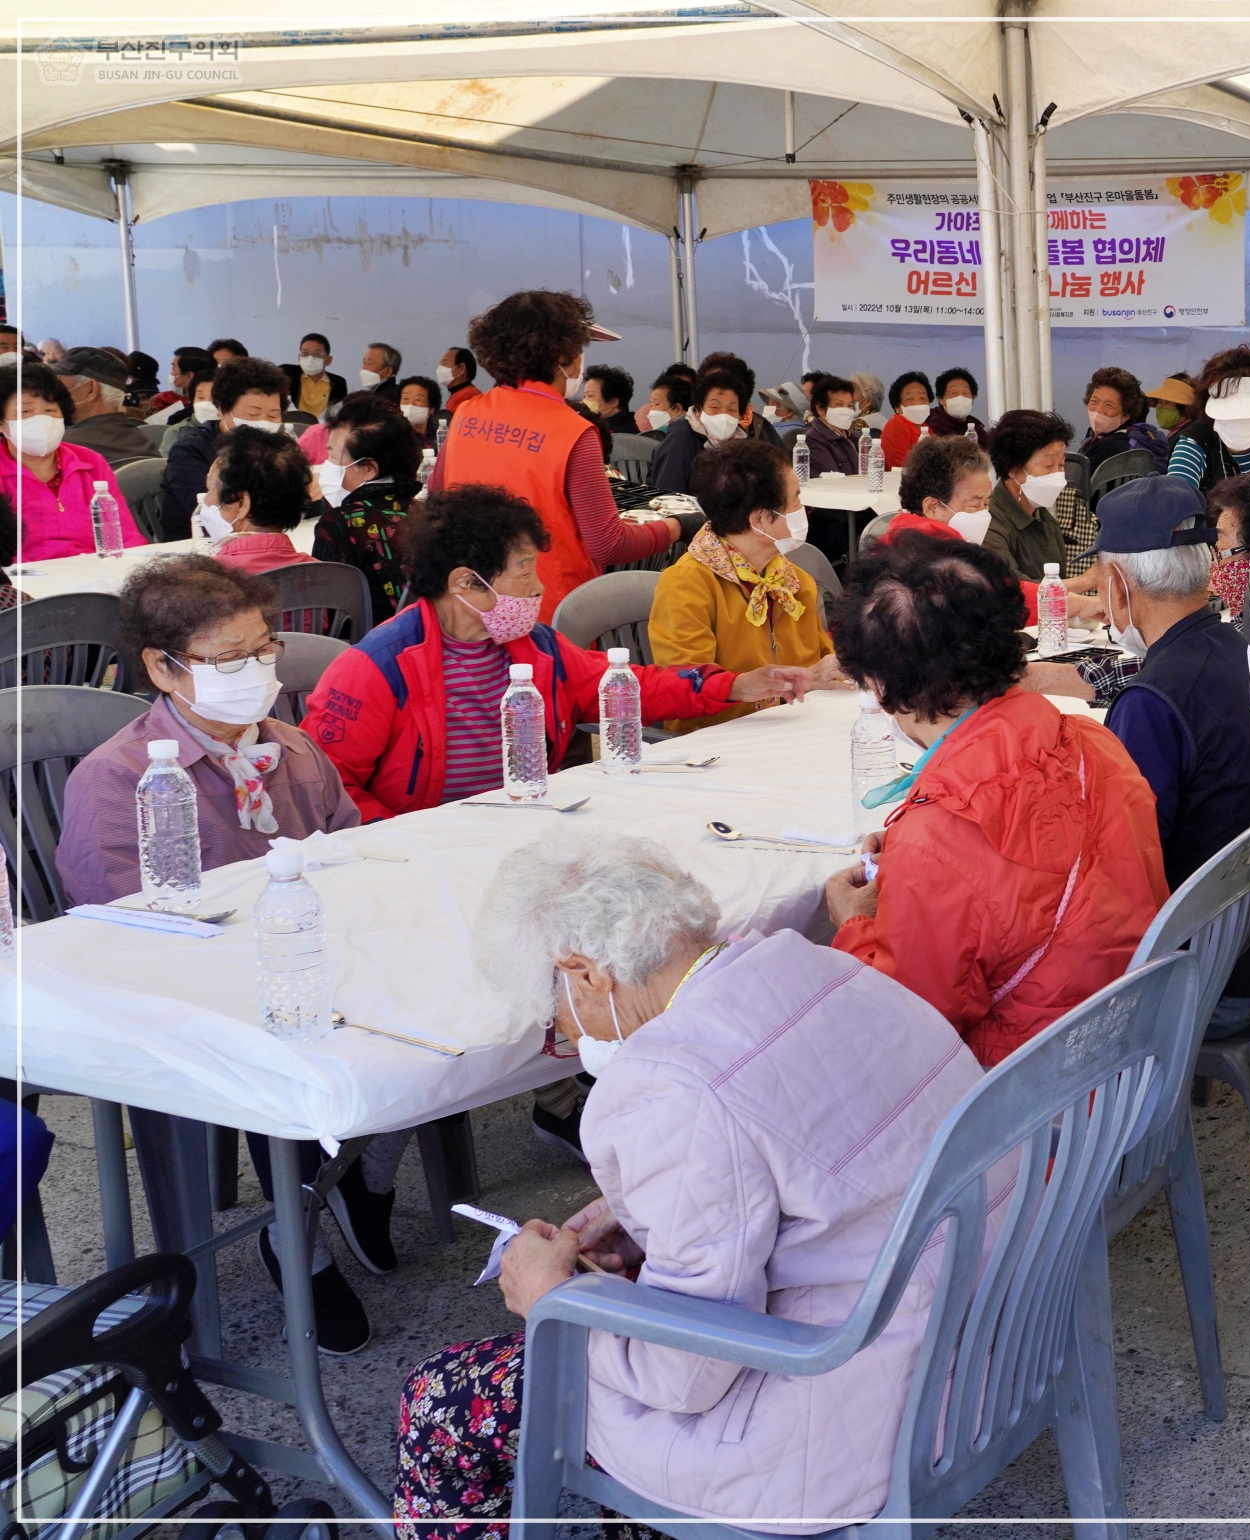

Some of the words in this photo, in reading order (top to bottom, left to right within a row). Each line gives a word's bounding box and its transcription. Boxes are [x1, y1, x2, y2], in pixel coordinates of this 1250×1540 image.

[887, 193, 950, 205] 주민생활현장의
[950, 194, 979, 205] 공공서
[1047, 209, 1107, 231] 께하는
[890, 238, 982, 265] 우리동네
[1092, 236, 1166, 265] 협의체
[906, 270, 978, 297] 어르신
[1048, 272, 1092, 298] 나눔
[1099, 269, 1146, 297] 행사
[859, 303, 883, 313] 2022년
[885, 304, 901, 314] 10월
[904, 305, 933, 315] 13일(목)
[1083, 308, 1096, 317] 지원
[1101, 308, 1136, 318] busanjin
[1178, 307, 1209, 316] 행정안전부
